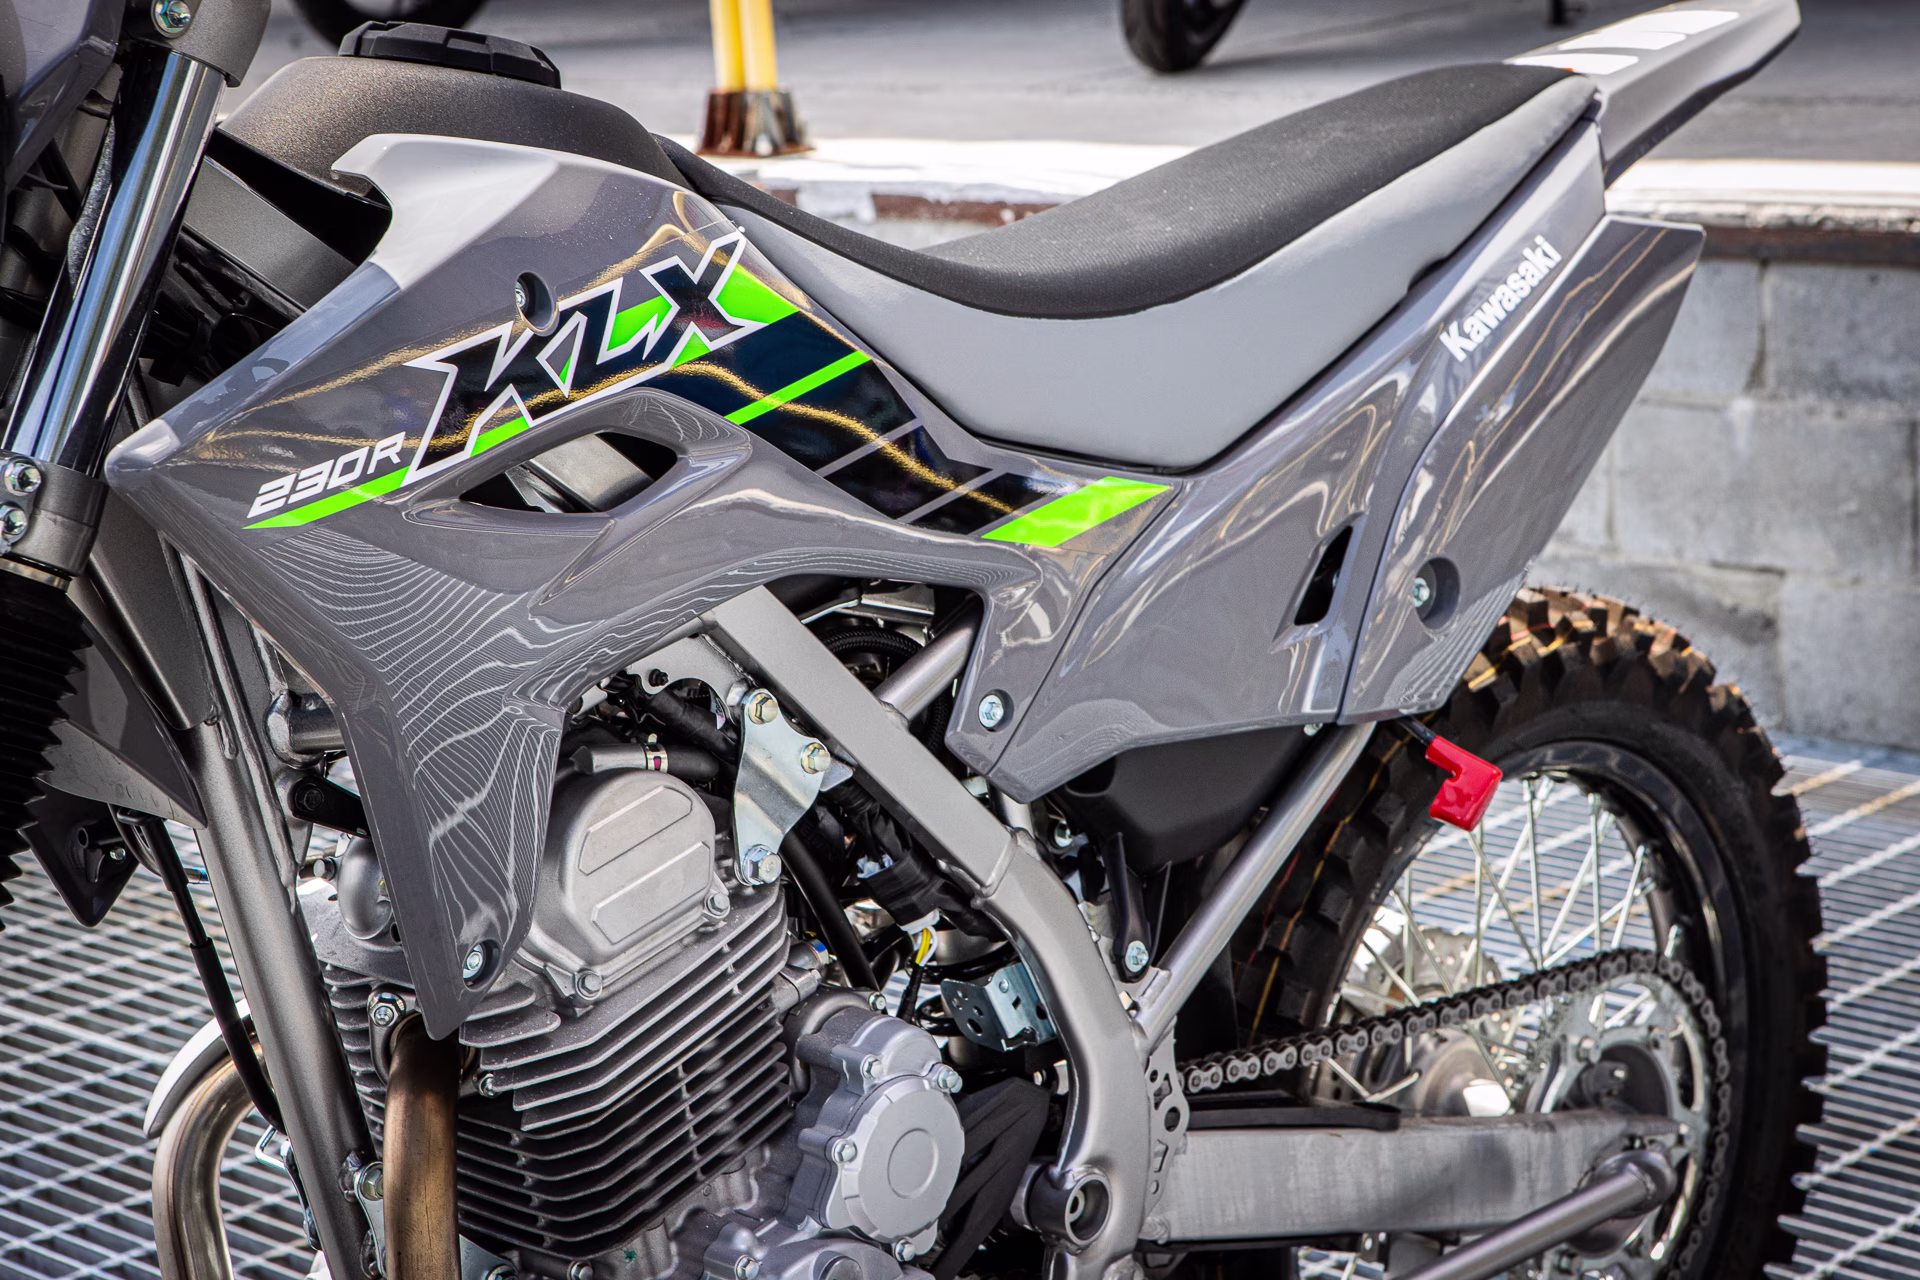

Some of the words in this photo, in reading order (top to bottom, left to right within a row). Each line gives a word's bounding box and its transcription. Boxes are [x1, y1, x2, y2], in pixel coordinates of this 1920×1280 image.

[402, 231, 768, 487] KLX
[1439, 235, 1562, 362] Kawasaki
[247, 431, 406, 518] 230R
